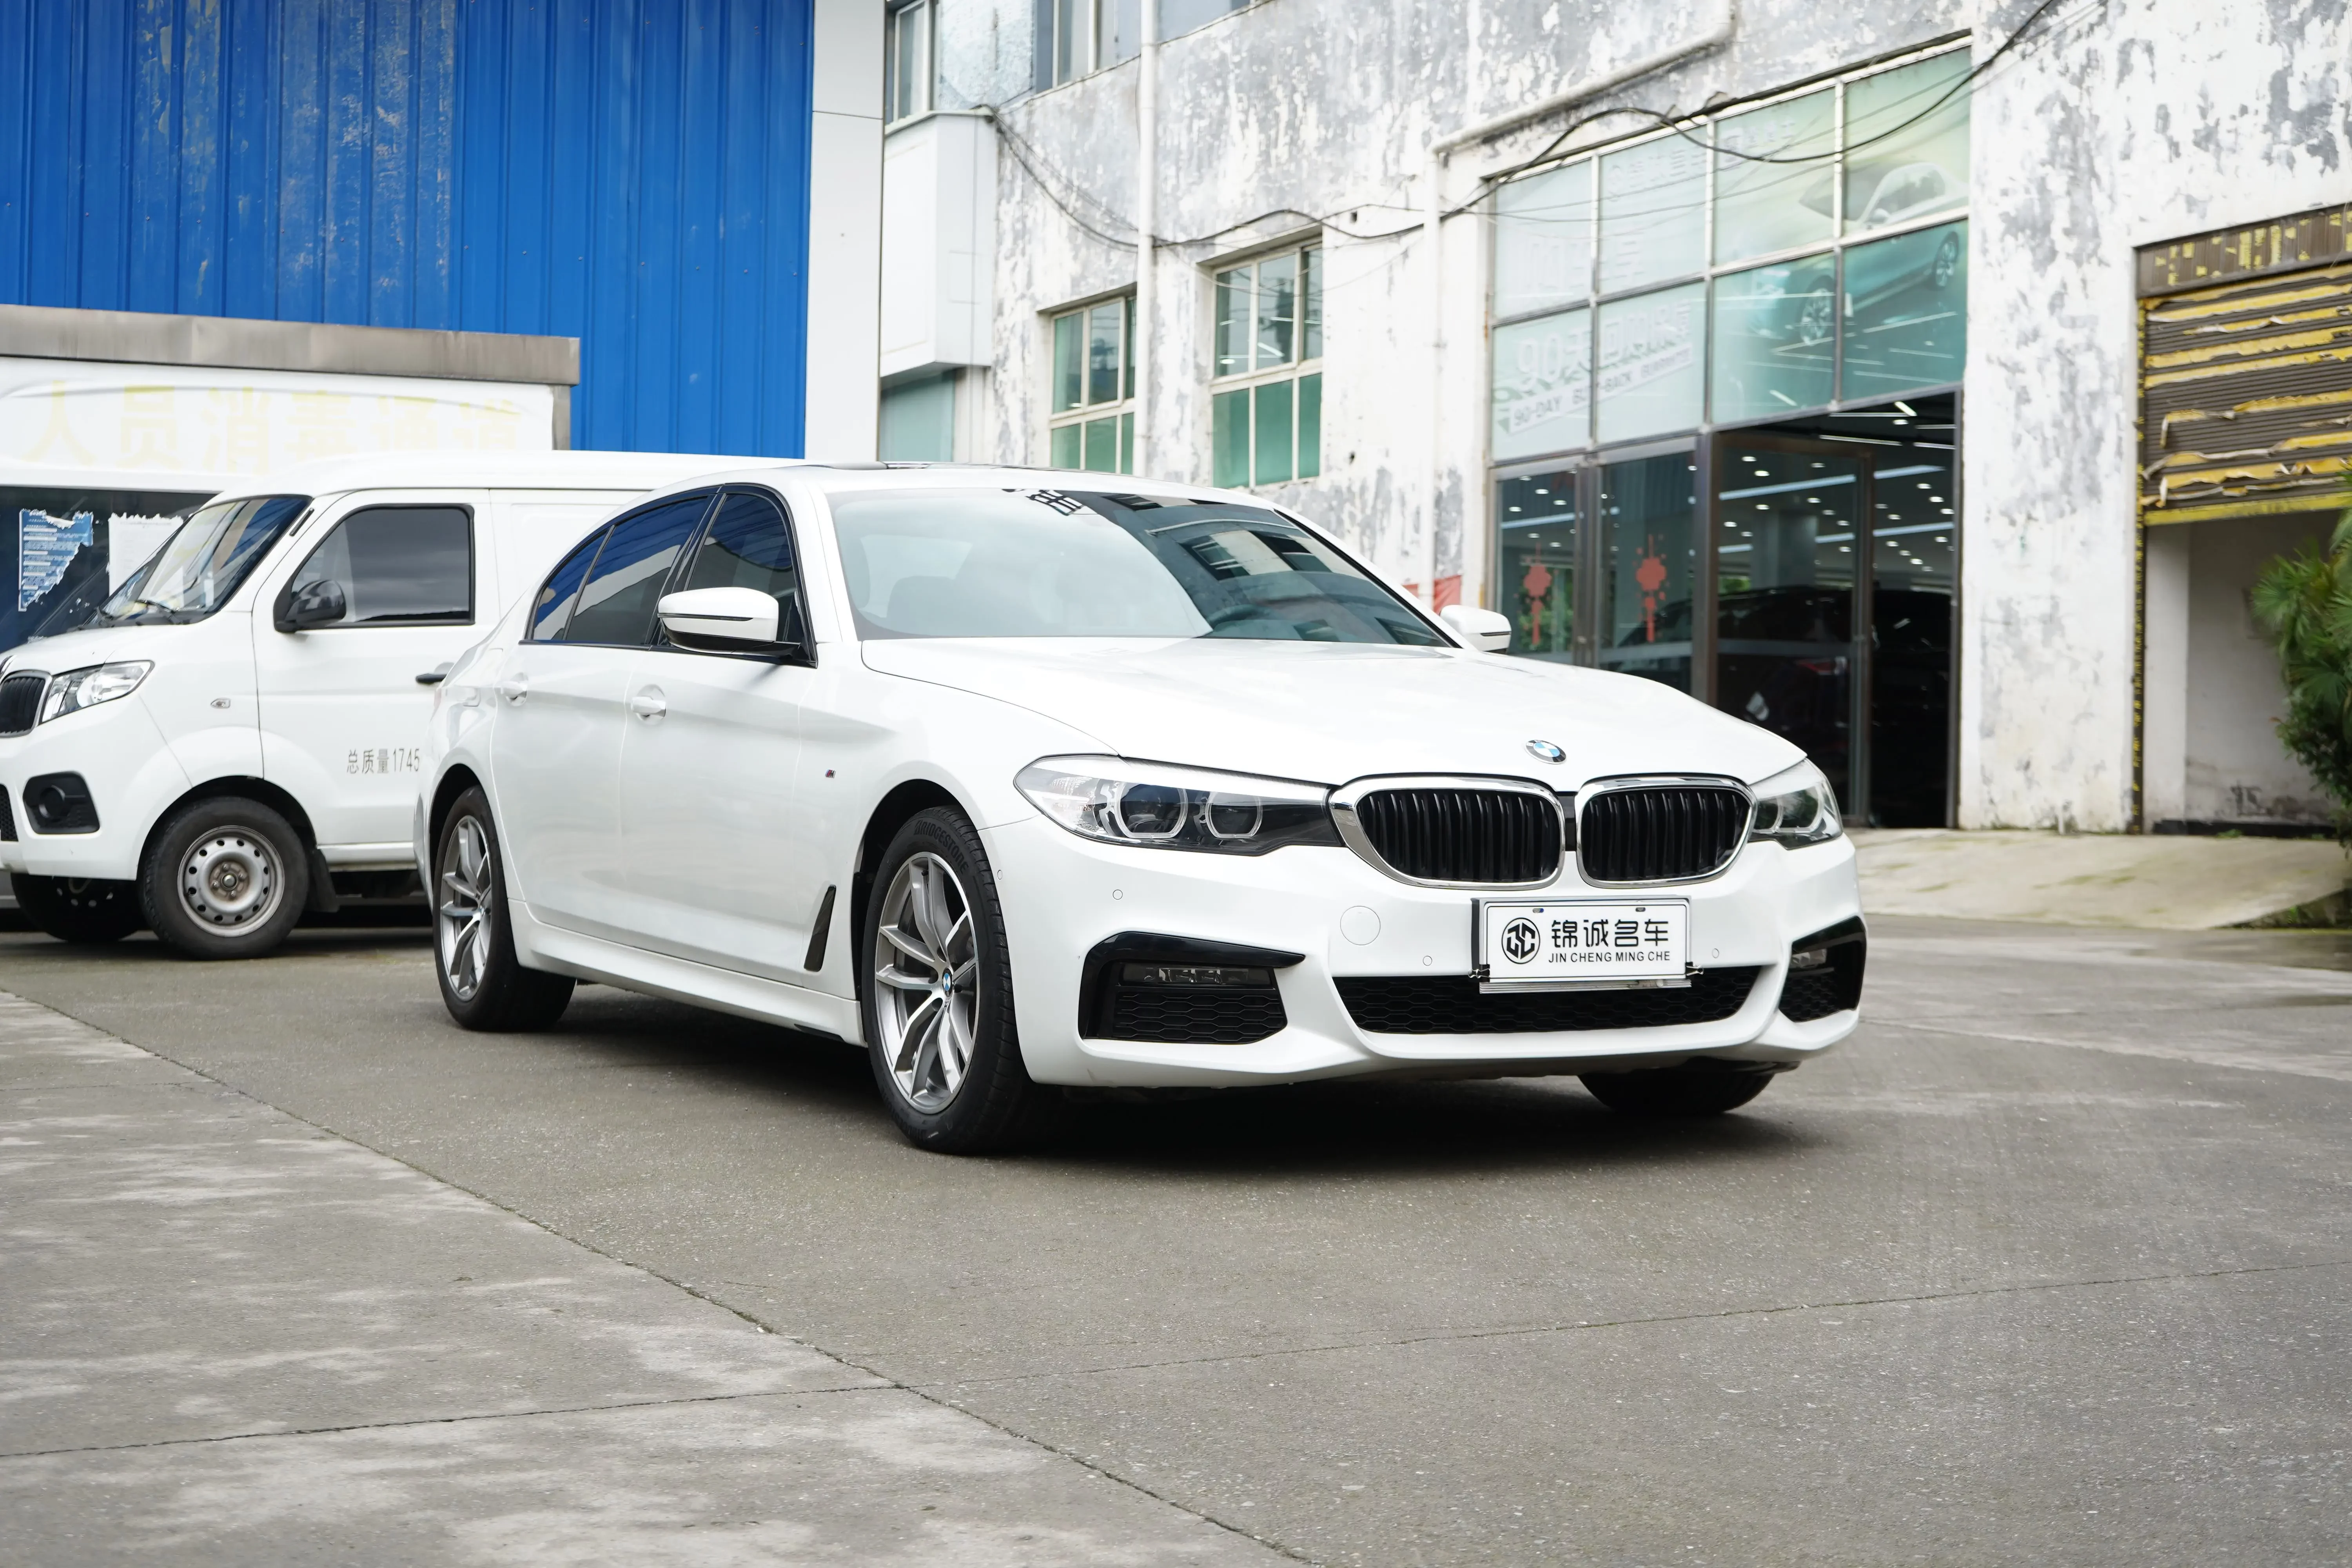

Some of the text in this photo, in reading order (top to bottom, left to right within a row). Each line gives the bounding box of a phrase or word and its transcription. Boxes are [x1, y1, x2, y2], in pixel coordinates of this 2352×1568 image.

[347, 748, 420, 774] 总质量1745
[914, 819, 969, 874] BRIDGESTONE
[1552, 919, 1668, 948] 锦诚名车
[1548, 951, 1670, 963] JIN CHENG MING CHE
